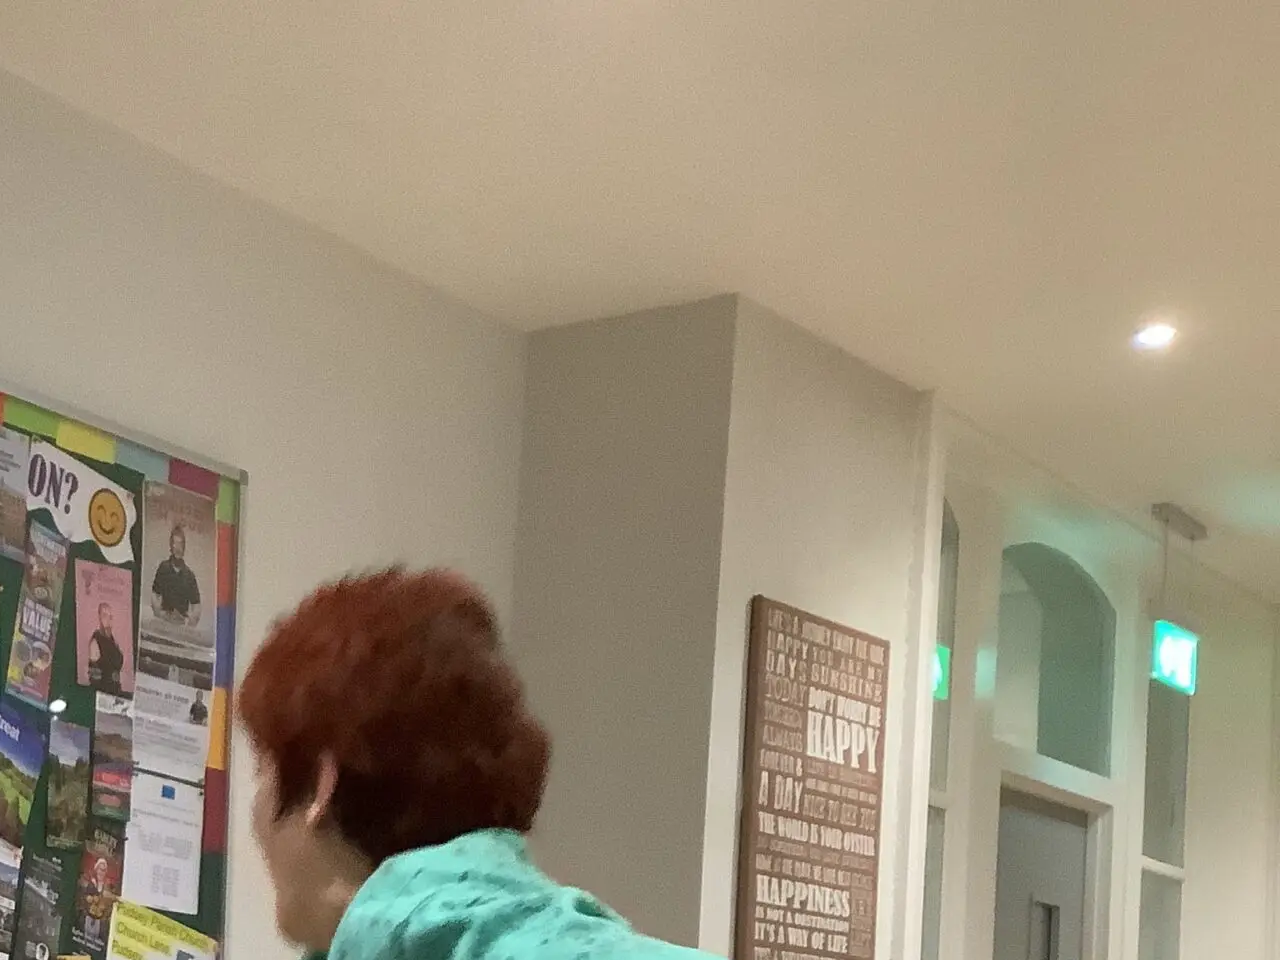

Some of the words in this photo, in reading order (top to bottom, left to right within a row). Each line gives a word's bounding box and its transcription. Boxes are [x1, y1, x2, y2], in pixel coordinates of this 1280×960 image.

[28, 453, 79, 515] ON?
[806, 709, 880, 773] HAPPY
[773, 774, 804, 814] DAY
[758, 811, 775, 836] THE
[777, 815, 809, 842] WORLD
[756, 873, 850, 917] HAPPINESS
[776, 925, 785, 944] A
[787, 926, 809, 947] WAY
[811, 931, 826, 951] OF
[827, 934, 848, 954] LIFE
